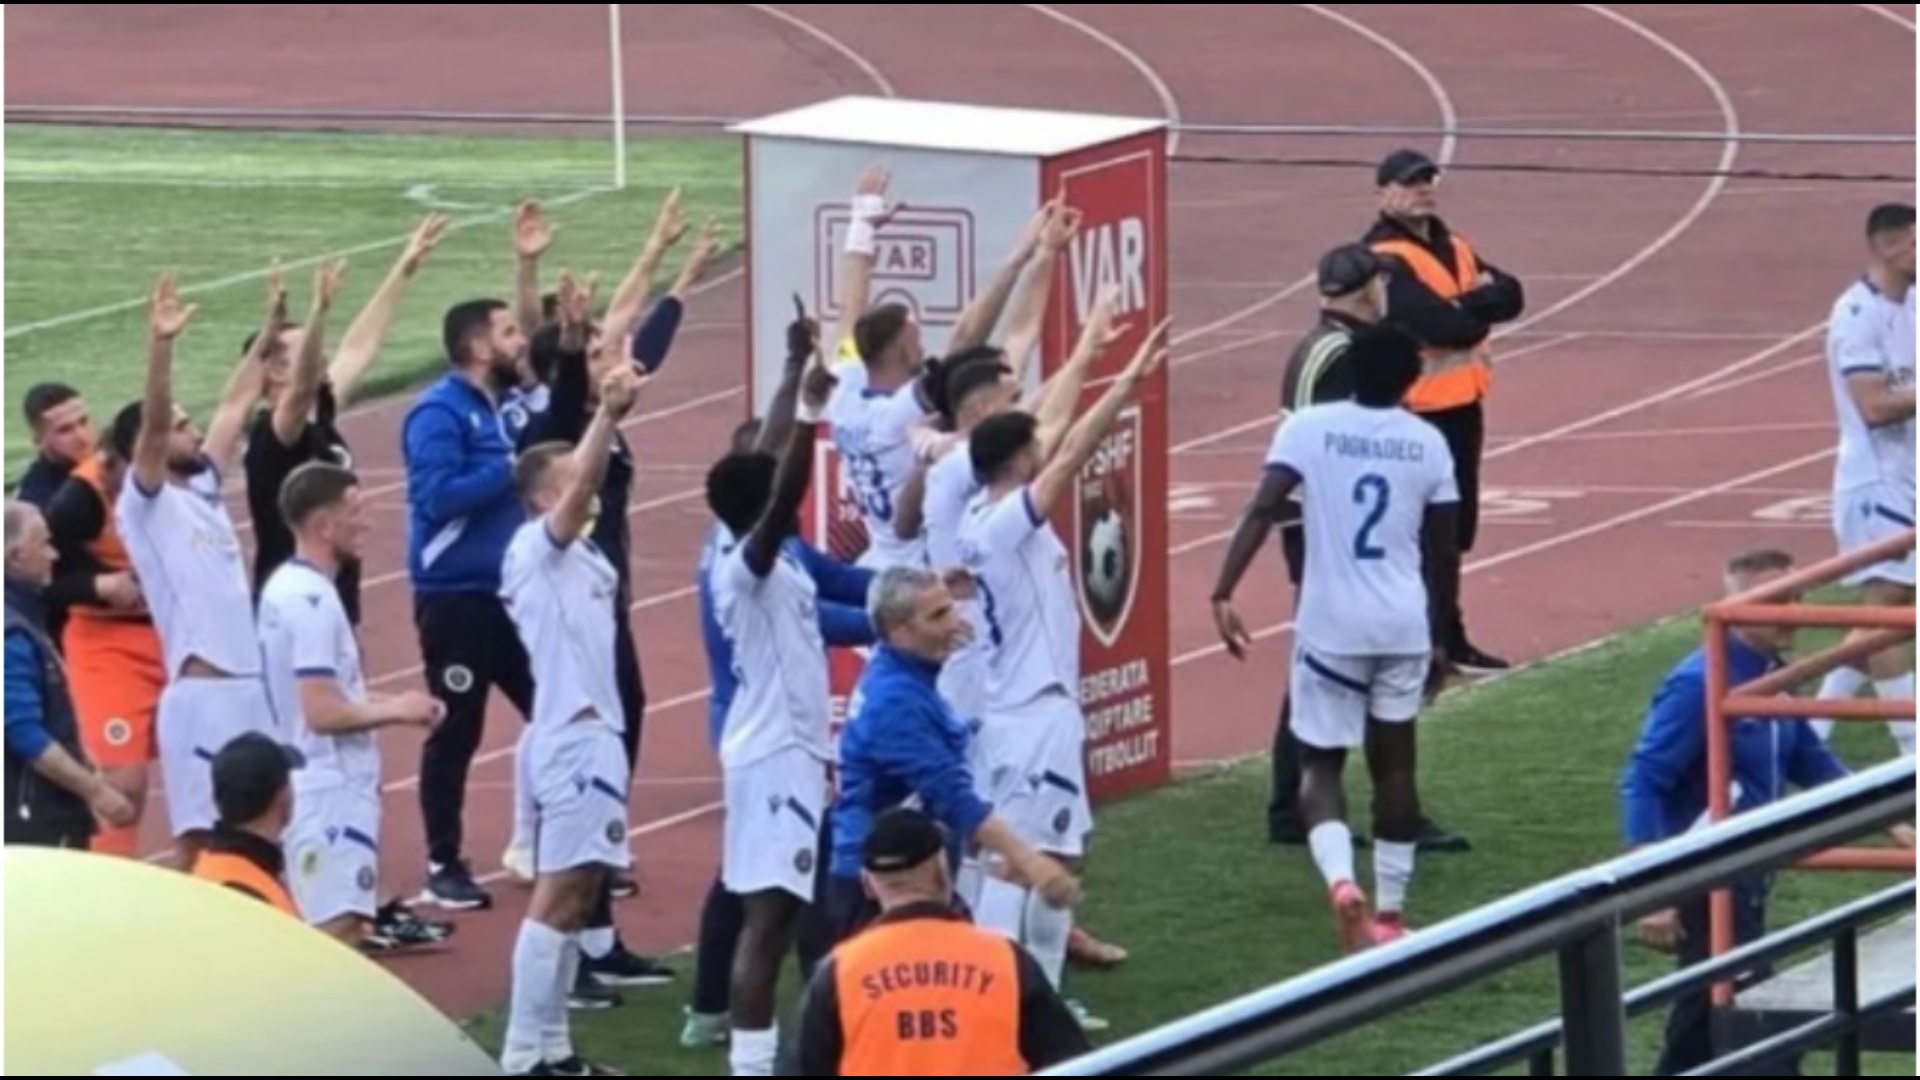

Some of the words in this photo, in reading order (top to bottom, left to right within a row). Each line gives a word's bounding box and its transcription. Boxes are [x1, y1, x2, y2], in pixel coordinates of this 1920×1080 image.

[868, 243, 929, 270] VAR
[1069, 216, 1146, 325] VAR
[1323, 431, 1424, 462] POGRADECI
[1352, 473, 1391, 560] 2
[1080, 657, 1149, 704] EDERATA
[1086, 693, 1153, 739] QIPTARE
[1089, 729, 1159, 776] TBOLLIT
[861, 960, 995, 999] SECURITY
[897, 1009, 957, 1040] BBS
